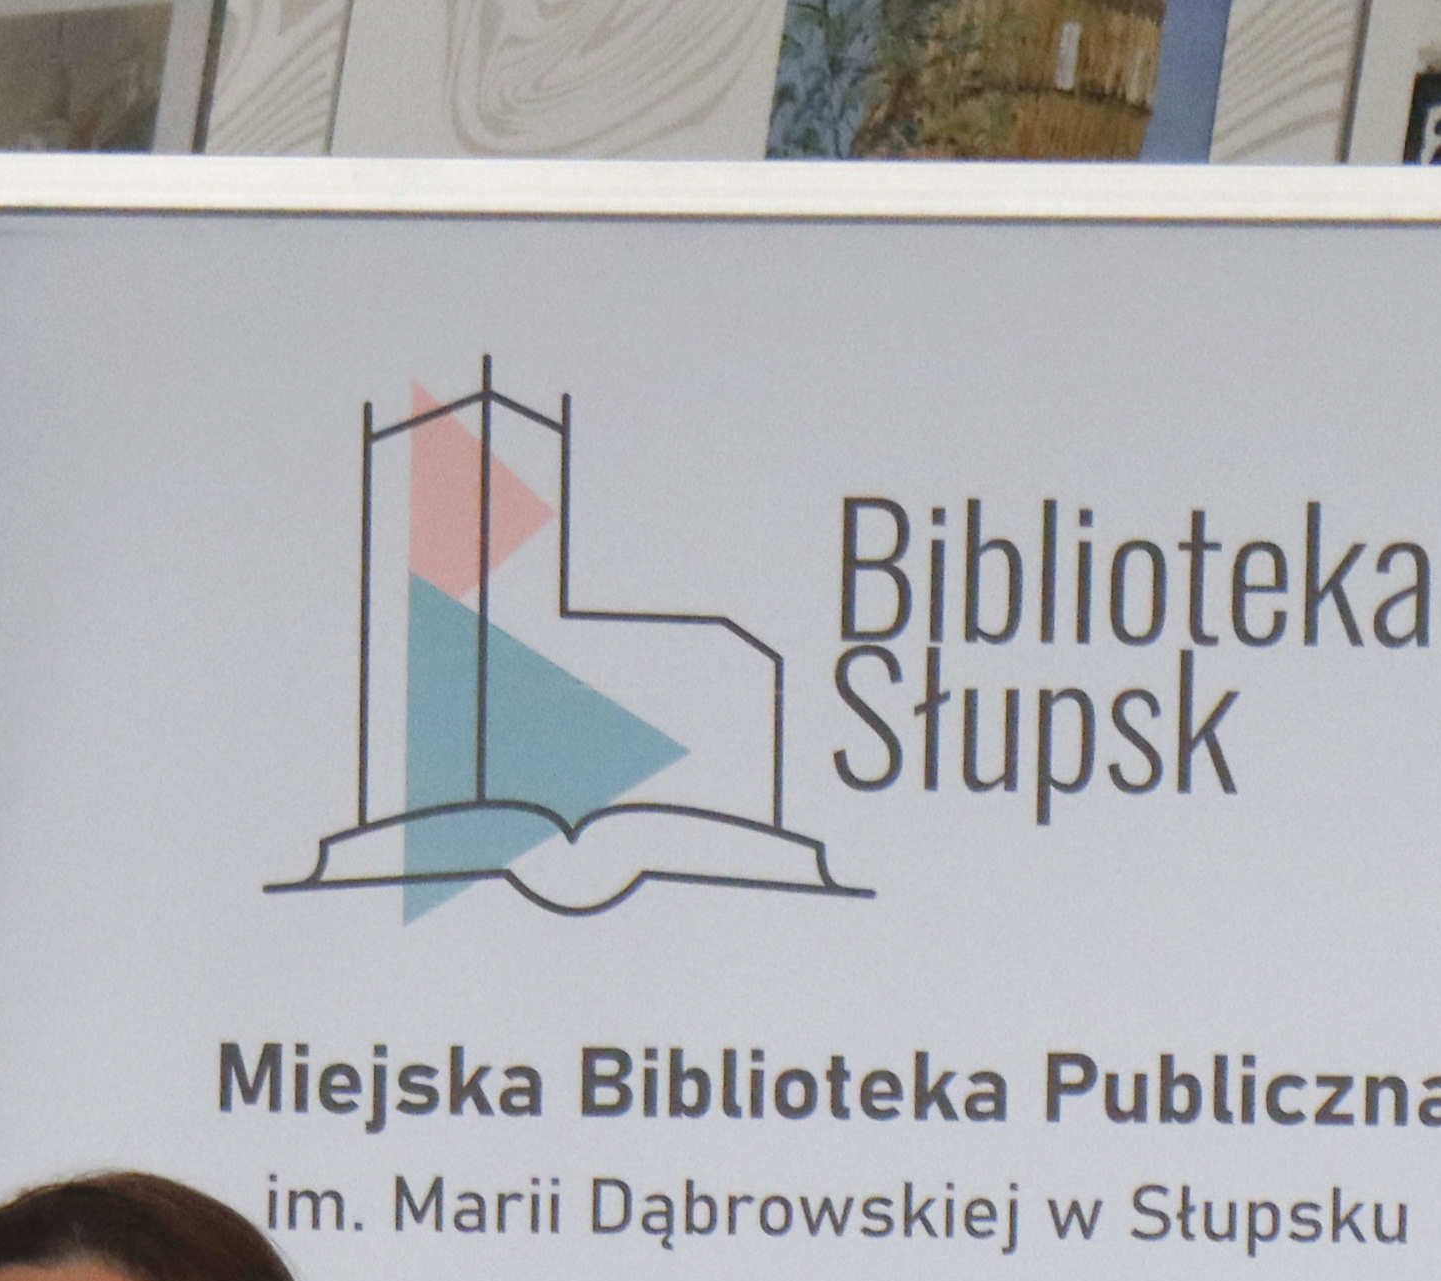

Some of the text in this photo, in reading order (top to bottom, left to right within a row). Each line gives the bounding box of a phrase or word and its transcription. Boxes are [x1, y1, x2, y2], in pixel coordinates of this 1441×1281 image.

[839, 495, 1433, 652] Biblioteka
[830, 642, 1241, 826] Słupsk
[217, 1040, 544, 1135] Miejska
[579, 1045, 1009, 1125] Biblioteka
[264, 1174, 1410, 1258] im. Marii Dąbrowskiej w Słupsku
